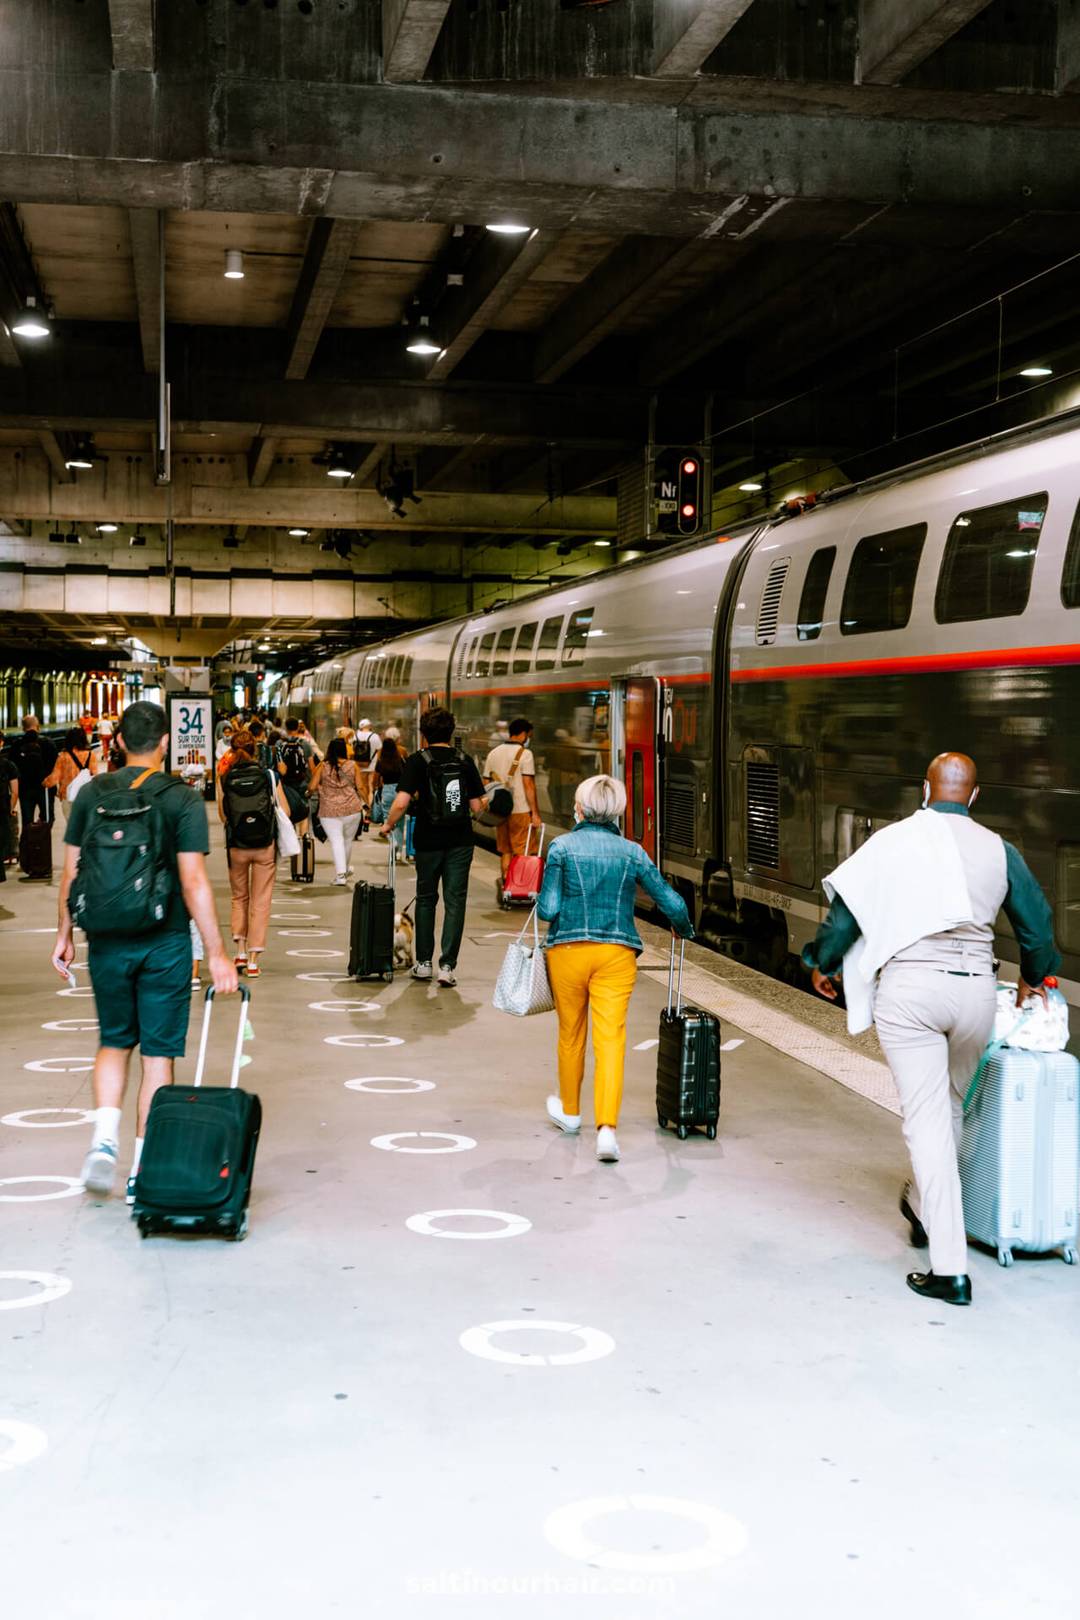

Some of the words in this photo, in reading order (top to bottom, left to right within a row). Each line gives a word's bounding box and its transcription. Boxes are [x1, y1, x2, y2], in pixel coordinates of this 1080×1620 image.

[178, 706, 204, 735] 34
[177, 735, 190, 744] SUR
[191, 735, 206, 743] TOUT
